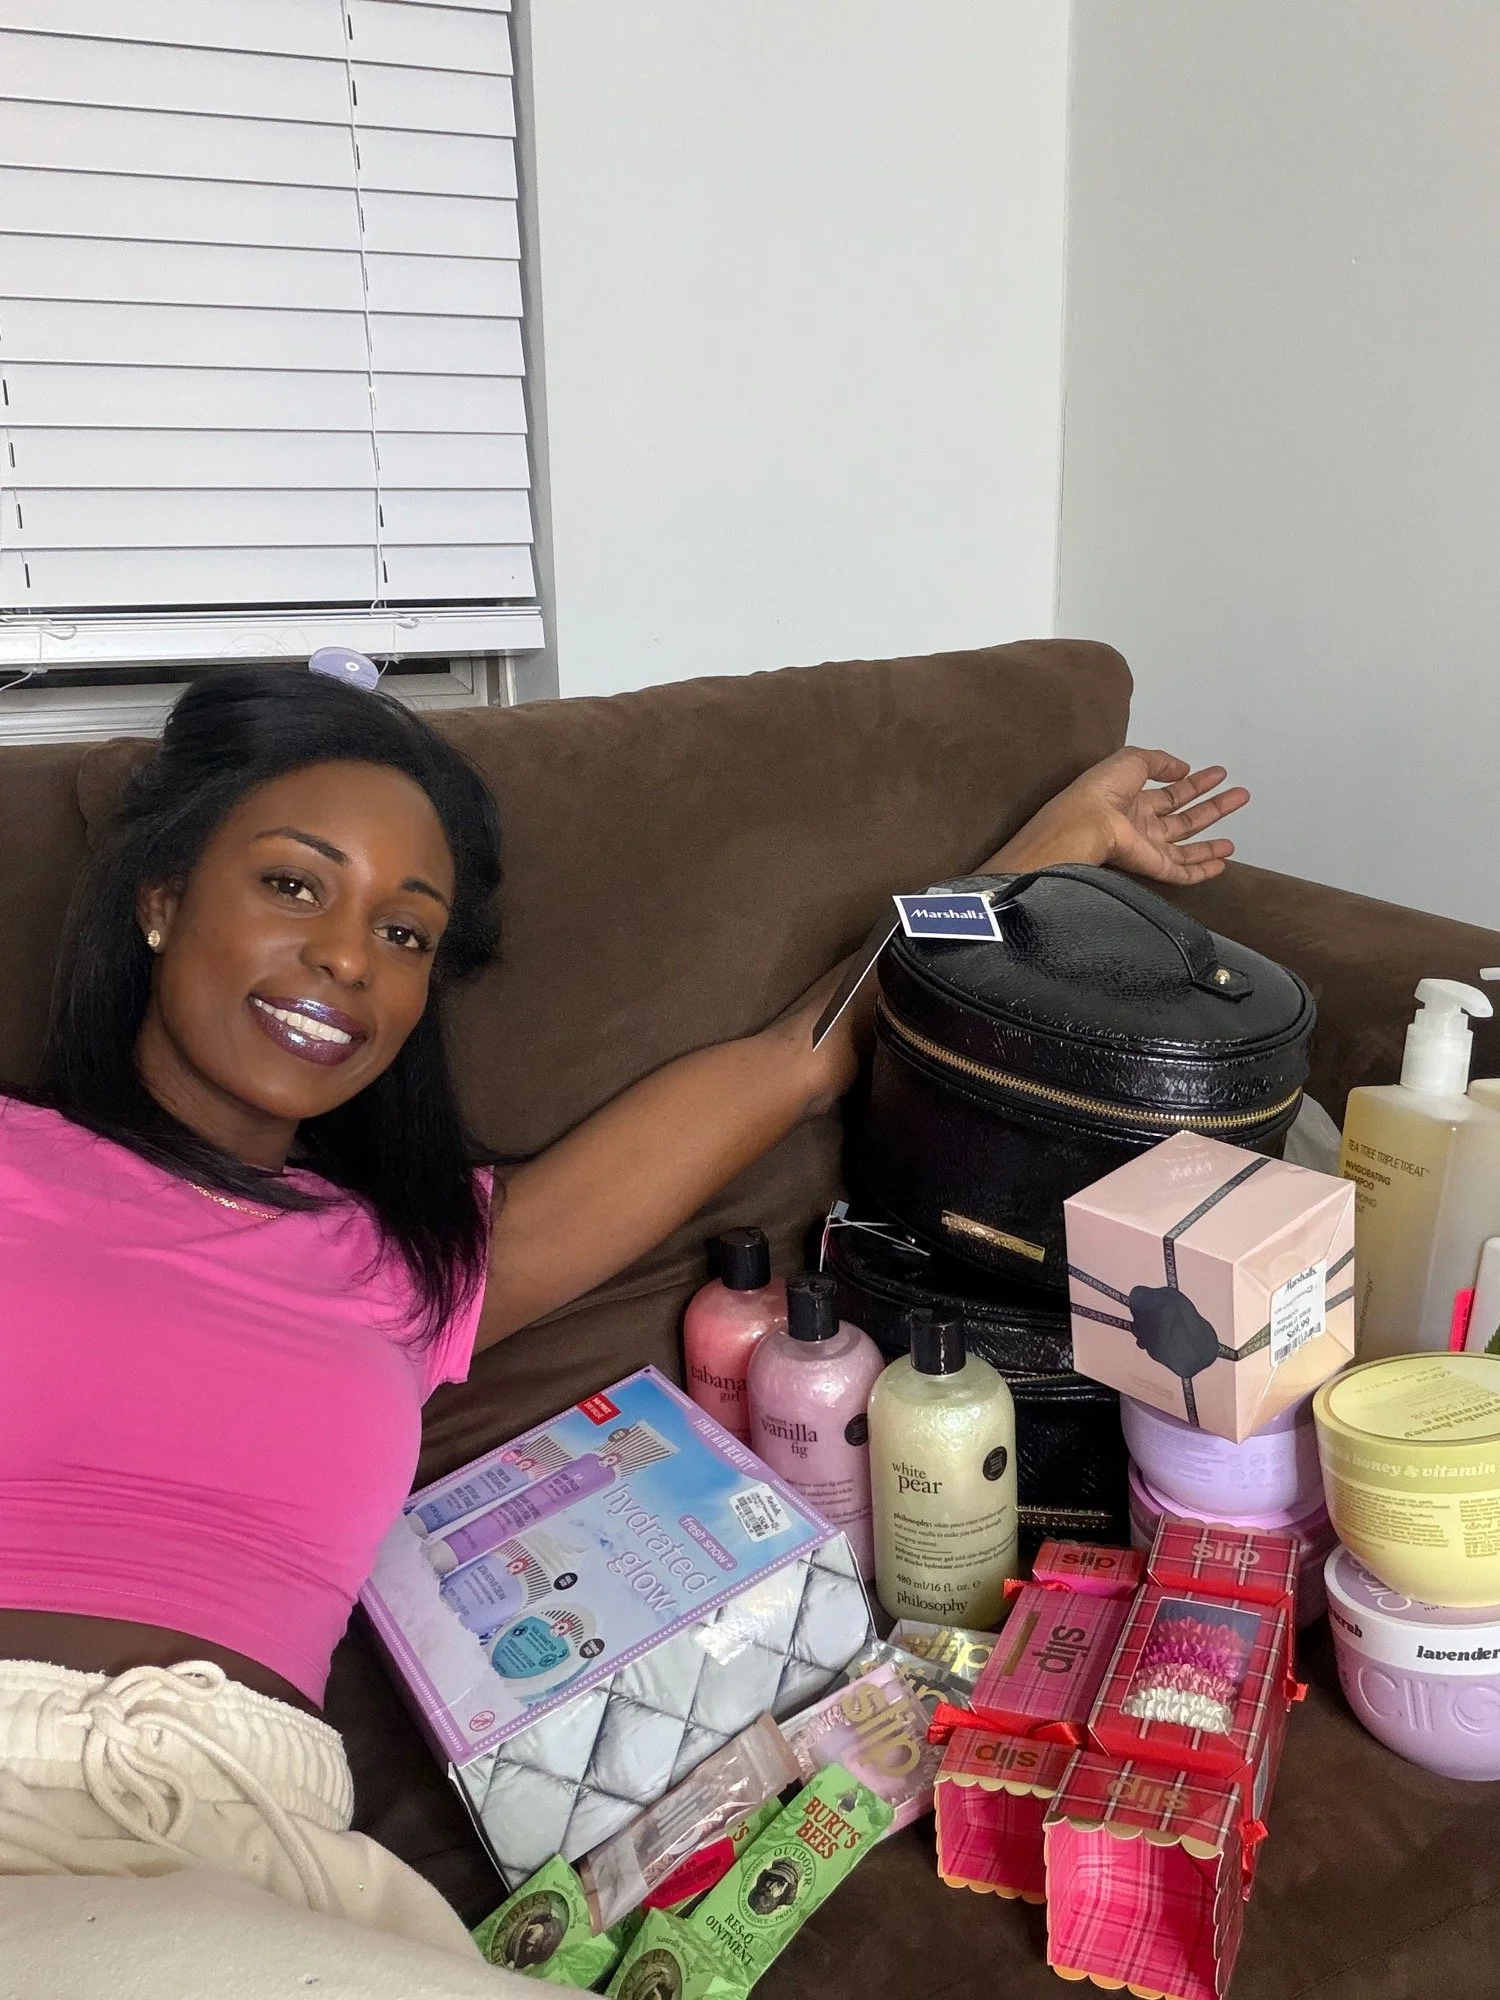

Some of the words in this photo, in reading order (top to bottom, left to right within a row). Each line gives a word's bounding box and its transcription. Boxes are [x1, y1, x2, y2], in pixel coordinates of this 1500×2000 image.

[910, 909, 985, 919] Marshalls
[1348, 1139, 1359, 1152] TEA
[1360, 1144, 1376, 1160] TREE
[1377, 1151, 1400, 1169] TRIPLE
[1345, 1160, 1391, 1185] INVIGORATING
[693, 1418, 713, 1438] FIRST
[712, 1433, 725, 1448] AID
[722, 1443, 756, 1471] BEAUTY
[761, 1419, 818, 1442] vanilla
[791, 1442, 808, 1458] fig
[892, 1462, 927, 1479] white
[898, 1474, 943, 1495] pear
[1404, 1465, 1418, 1478] &
[1421, 1462, 1496, 1478] vitamin
[602, 1482, 717, 1595] hydrated
[681, 1517, 703, 1545] fresh
[702, 1538, 730, 1564] snow
[1061, 1551, 1116, 1570] slip
[1192, 1540, 1261, 1568] slip
[607, 1550, 678, 1613] glow
[896, 1573, 912, 1587] 480
[913, 1580, 941, 1592] ml/16
[943, 1582, 954, 1593] fl.
[956, 1582, 970, 1592] oz.
[896, 1591, 968, 1615] philosophy
[1032, 1625, 1090, 1673] slip
[841, 1682, 920, 1777] slip
[974, 1742, 1040, 1768] slip
[1106, 1776, 1189, 1812] slip
[803, 1796, 863, 1849] BURT'S
[796, 1819, 840, 1860] BEES
[773, 1847, 813, 1887] OUTDOOR
[706, 1915, 755, 1967] OINTMENT
[724, 1912, 755, 1949] RES-Q
